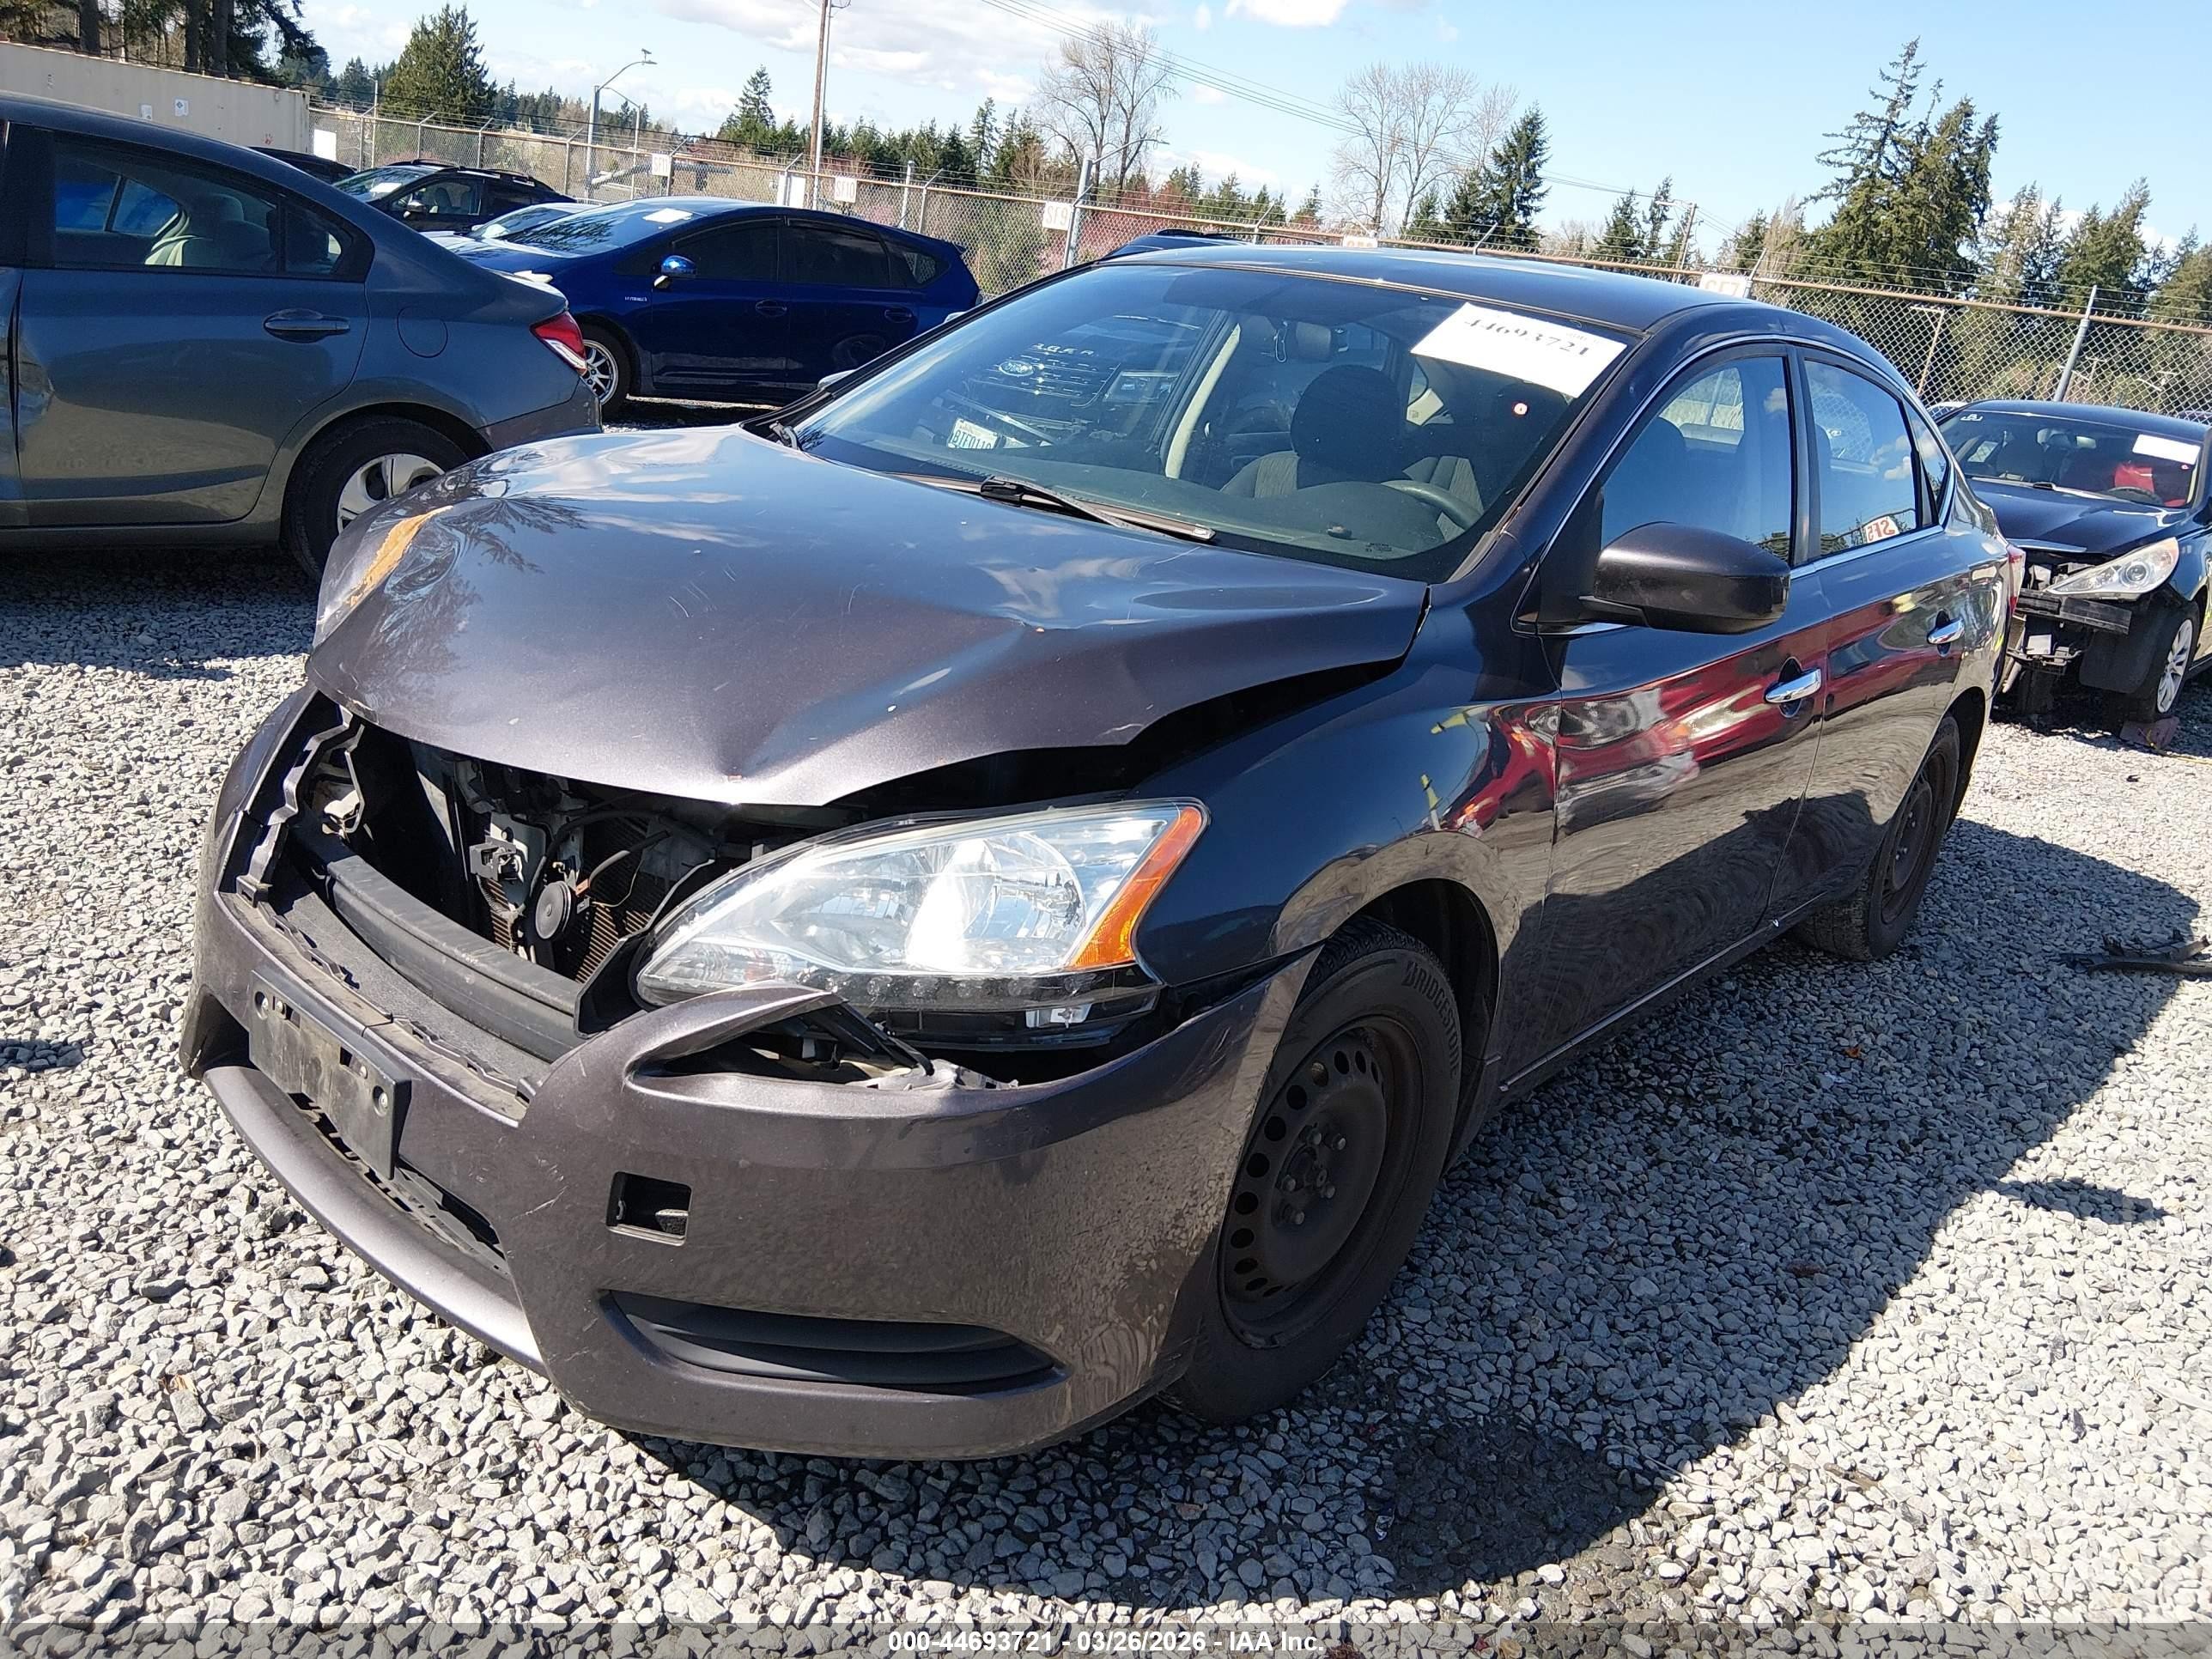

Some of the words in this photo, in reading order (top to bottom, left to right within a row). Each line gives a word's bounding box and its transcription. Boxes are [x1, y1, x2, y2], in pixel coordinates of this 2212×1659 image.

[836, 179, 855, 199] SF10
[1045, 205, 1069, 226] SF9
[1401, 961, 1462, 1077] BRIDGESTONE
